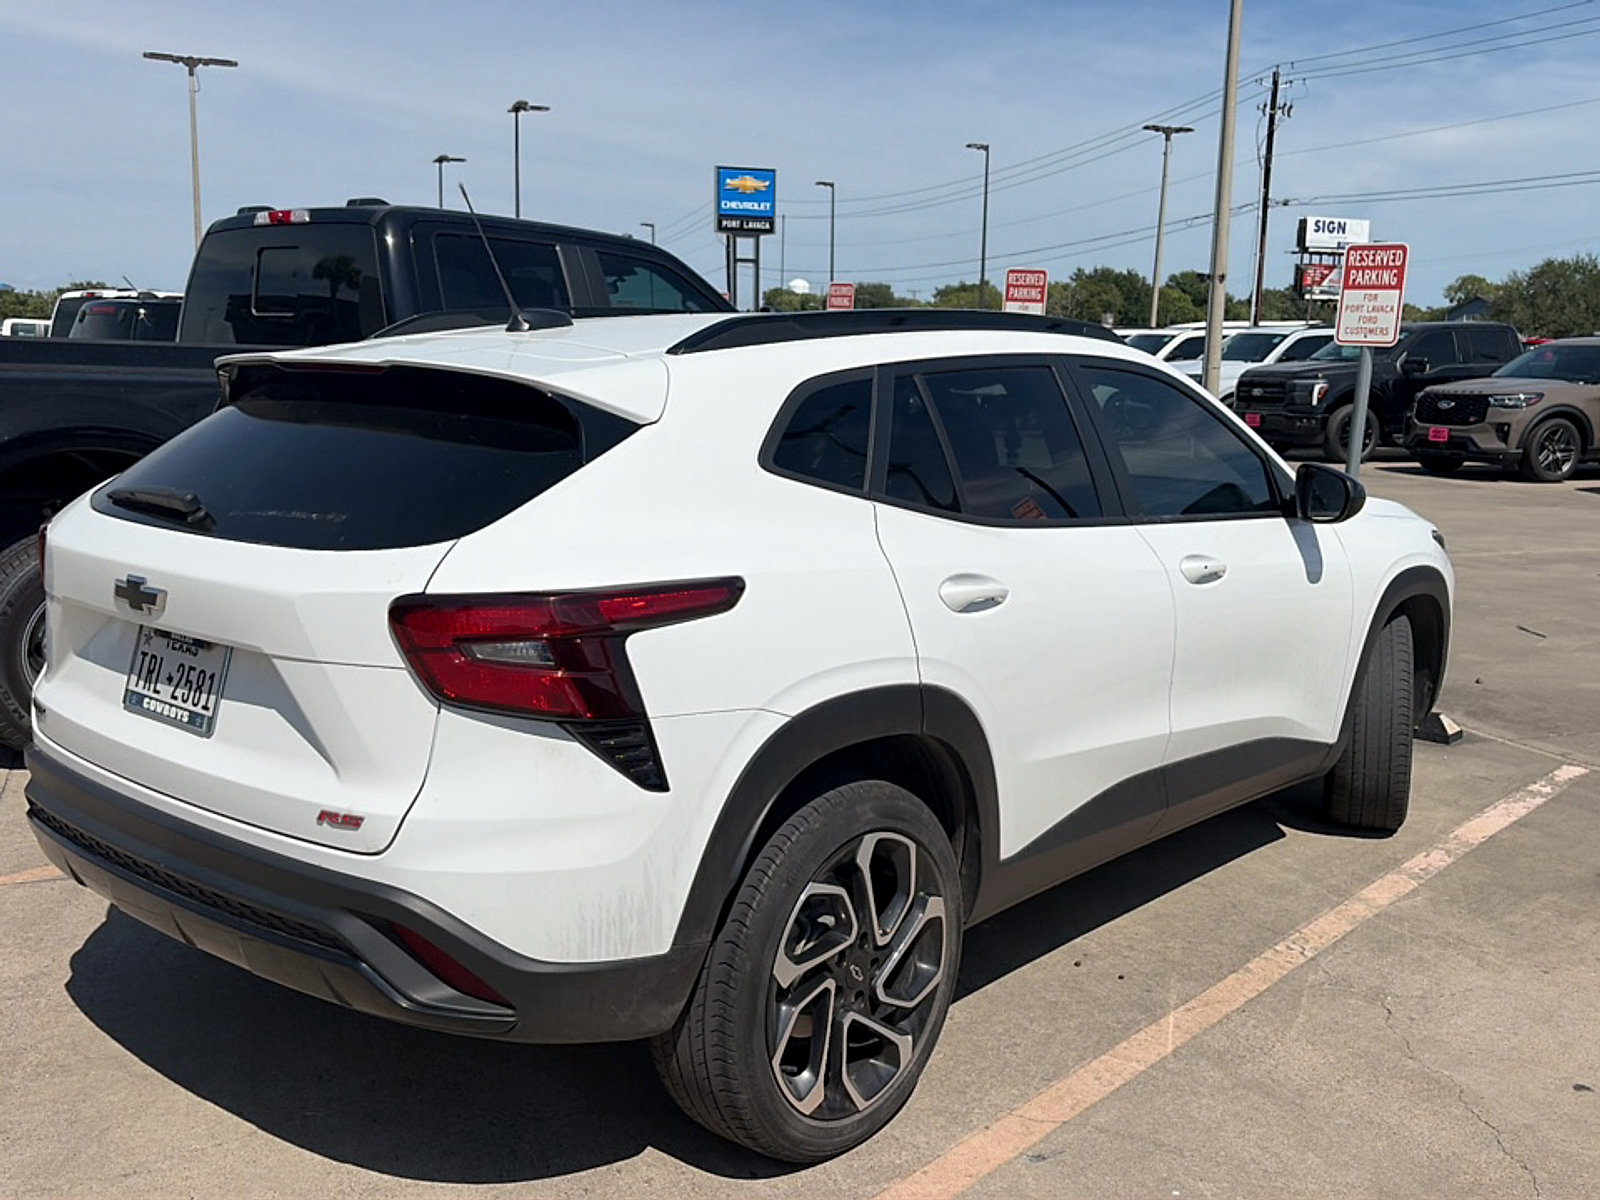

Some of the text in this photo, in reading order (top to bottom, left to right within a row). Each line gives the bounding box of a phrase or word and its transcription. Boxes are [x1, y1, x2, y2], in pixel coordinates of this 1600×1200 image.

[721, 200, 771, 210] CHEVROLET
[1313, 219, 1346, 234] SIGN
[1348, 250, 1404, 267] RESERVED
[1349, 270, 1398, 285] PARKING
[1363, 293, 1379, 302] FOR
[1345, 304, 1395, 313] PORT LAVACA
[1358, 315, 1378, 325] FORD
[1345, 326, 1390, 336] CUSTOMERS
[166, 640, 199, 656] TEXAS
[142, 697, 190, 723] COWBOYS
[316, 809, 365, 831] RS
